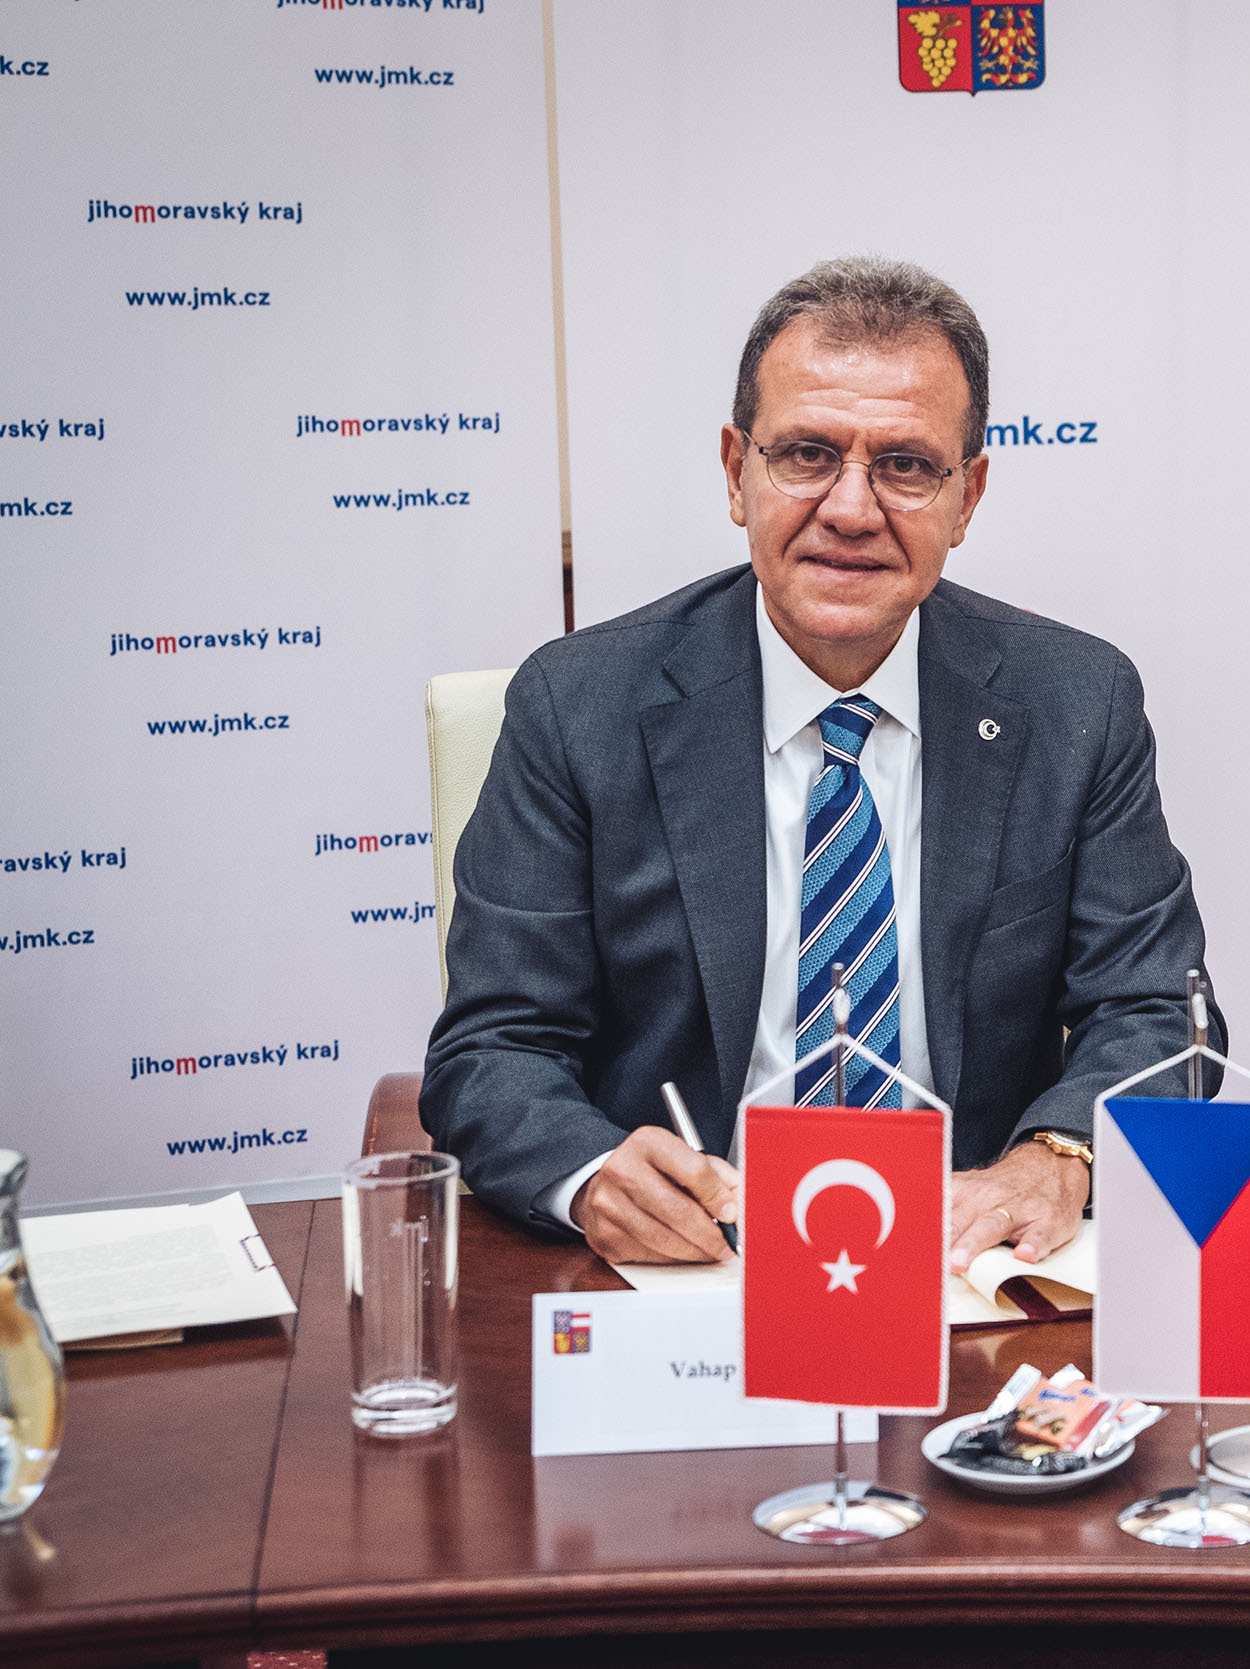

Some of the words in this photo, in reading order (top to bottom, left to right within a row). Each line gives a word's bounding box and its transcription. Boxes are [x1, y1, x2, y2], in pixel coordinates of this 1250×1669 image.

[315, 66, 454, 88] www.jmk.cz
[88, 200, 249, 224] jihomoravský
[259, 202, 302, 224] kraj
[126, 287, 270, 310] www.jmk.cz
[59, 419, 104, 440] kraj
[297, 414, 449, 437] jihomoravský
[459, 413, 499, 433] kraj
[333, 488, 469, 511] www.jmk.cz
[110, 629, 268, 656] jihomoravský
[278, 626, 320, 647] kraj
[147, 713, 289, 736] www.jmk.cz
[315, 833, 433, 856] jihomorav
[0, 851, 71, 872] avský
[81, 847, 126, 869] kraj
[131, 1045, 287, 1080] jihomoravský
[297, 1040, 339, 1061] kraj
[167, 1128, 307, 1155] www.jmk.cz
[670, 1361, 736, 1382] Vahap
